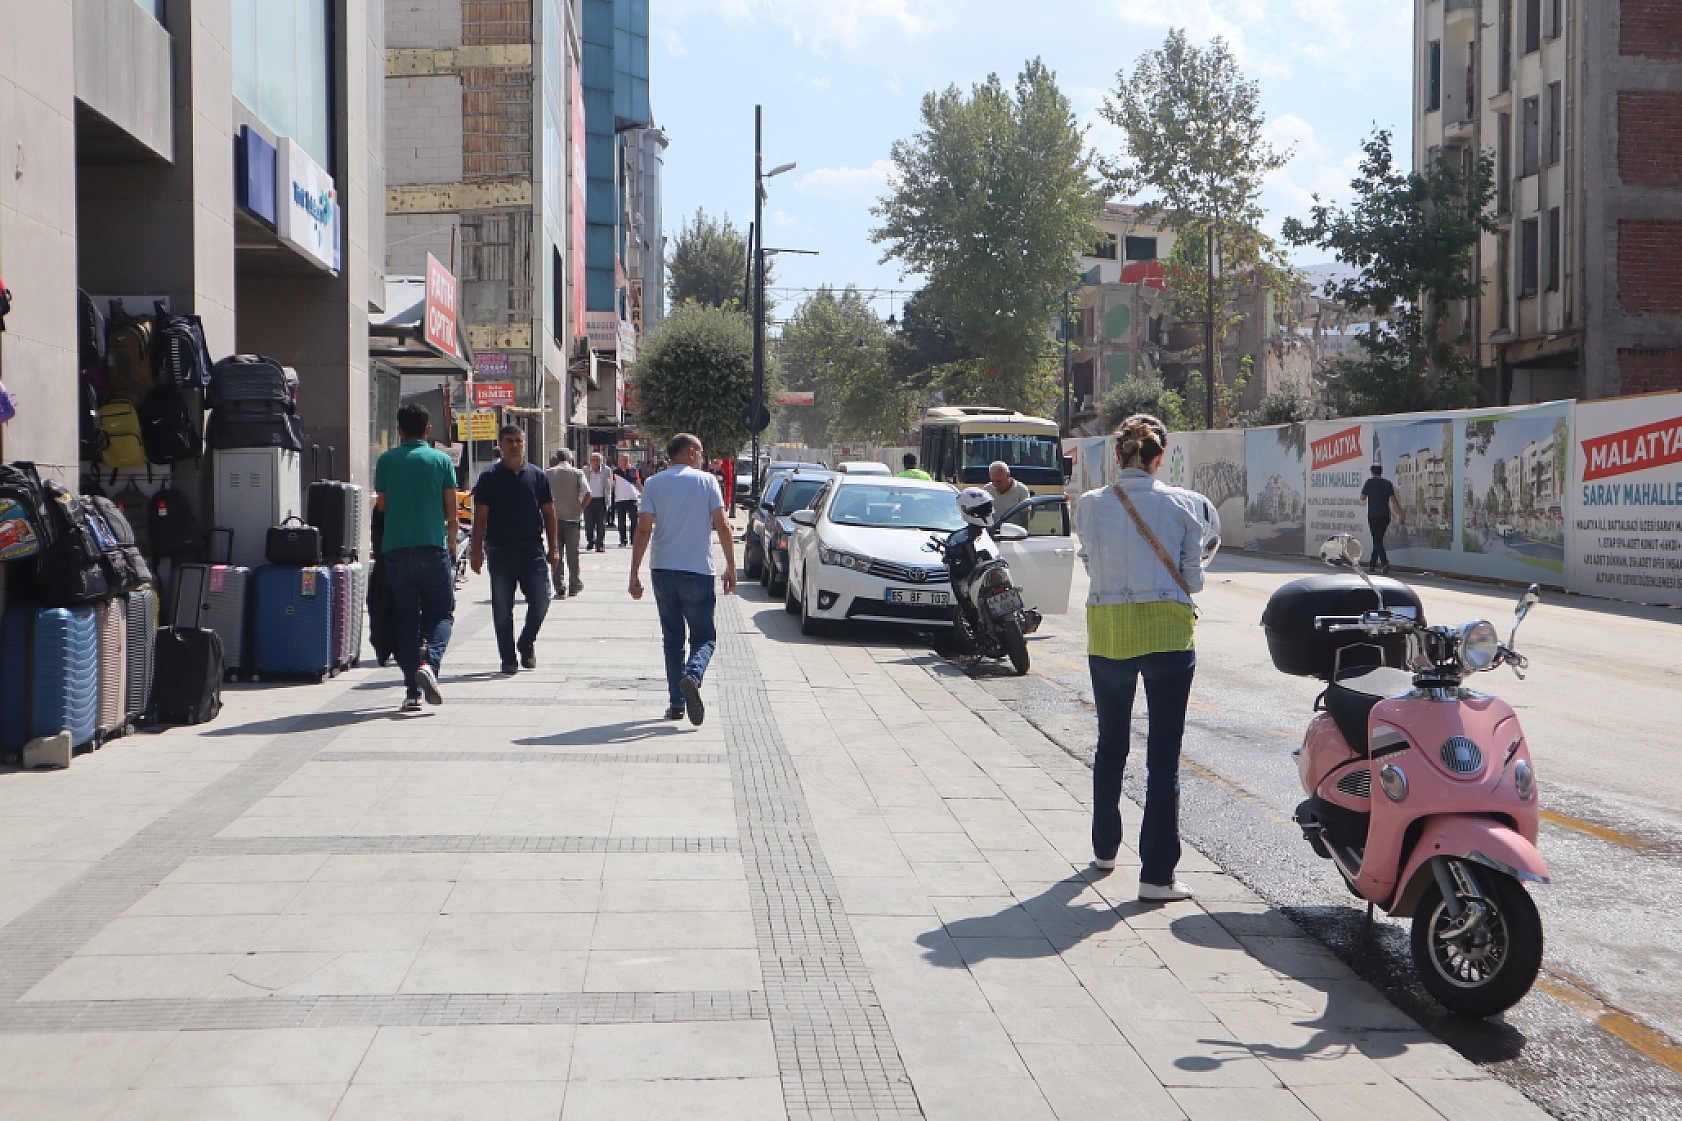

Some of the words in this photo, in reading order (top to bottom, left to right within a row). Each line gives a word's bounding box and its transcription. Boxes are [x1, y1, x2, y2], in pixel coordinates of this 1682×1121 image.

[1315, 434, 1358, 464] MALATYA
[1591, 426, 1682, 472] MALATYA
[1582, 483, 1620, 506] SARAY
